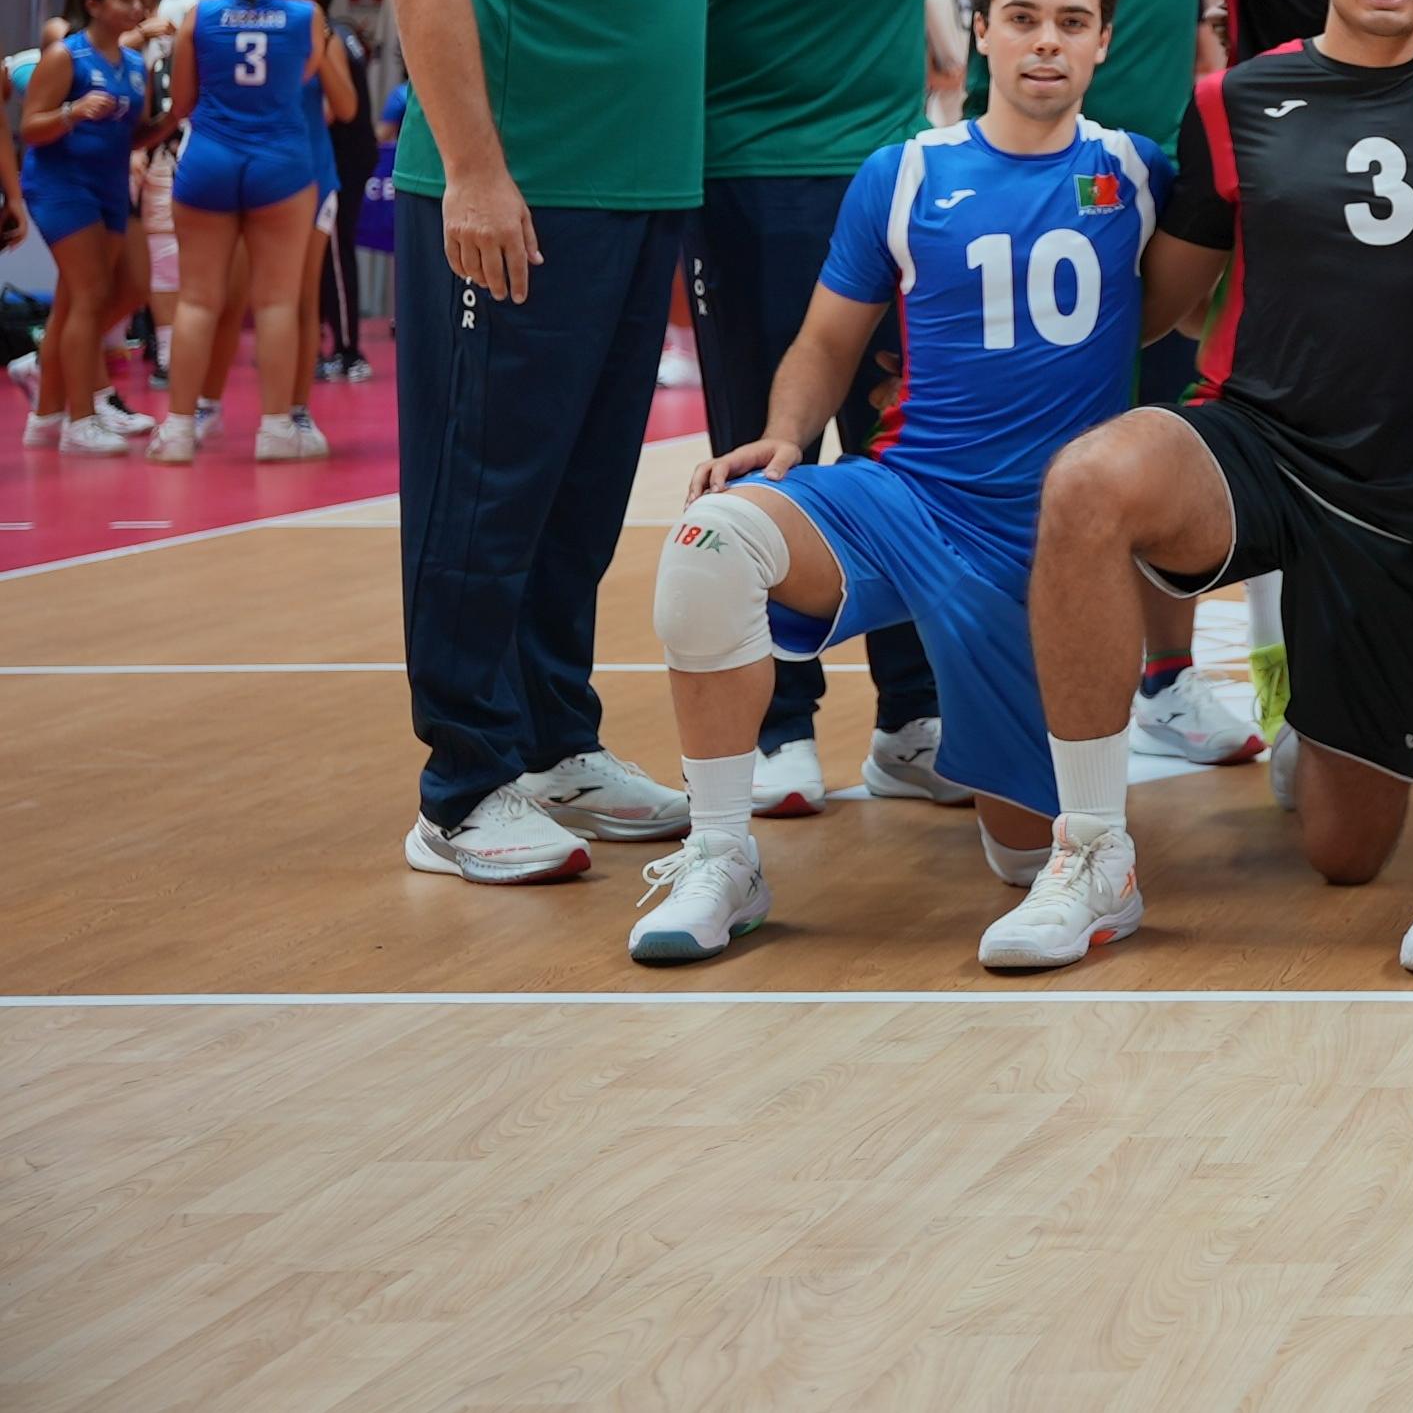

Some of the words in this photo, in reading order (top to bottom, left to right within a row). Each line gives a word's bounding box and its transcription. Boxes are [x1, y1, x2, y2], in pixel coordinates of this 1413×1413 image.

[234, 31, 268, 86] 3
[965, 228, 1102, 350] 10
[675, 523, 714, 548] 181
